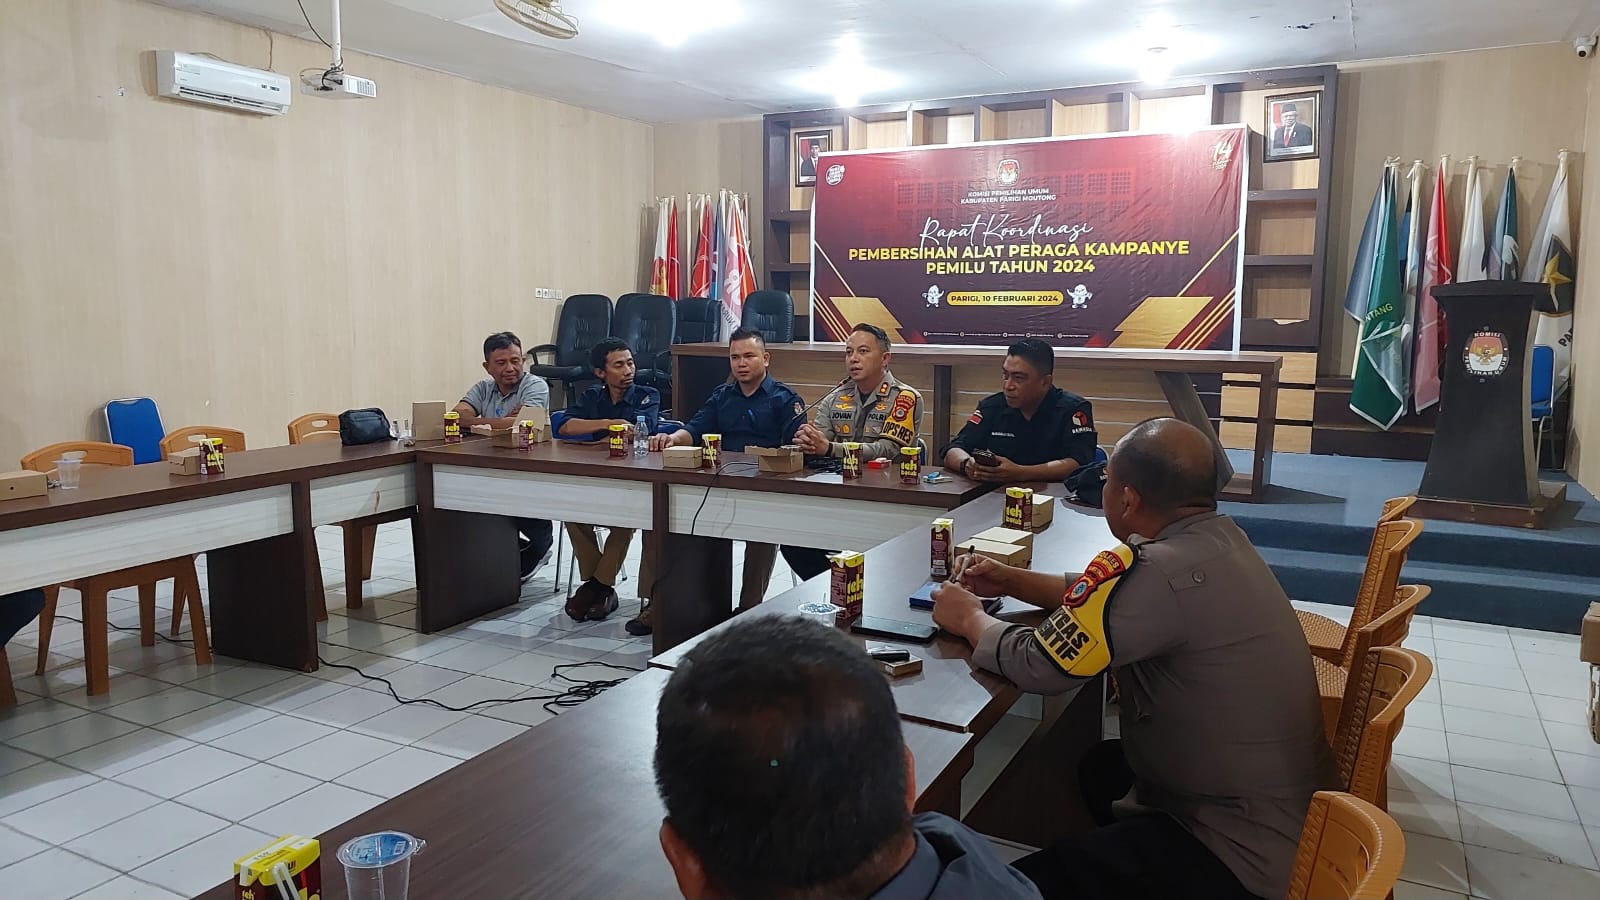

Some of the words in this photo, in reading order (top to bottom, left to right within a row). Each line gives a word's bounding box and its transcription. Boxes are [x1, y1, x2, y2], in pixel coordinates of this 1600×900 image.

[991, 189, 1026, 197] PEMILIHAN
[1022, 194, 1057, 202] MOUTONG
[920, 214, 987, 250] Rapat
[983, 214, 1093, 247] Koordinasi
[848, 246, 958, 261] PEMBERSIHAN
[961, 244, 1005, 259] ALAT
[1008, 242, 1080, 258] PERAGA
[1084, 240, 1190, 256] KAMPANYE
[926, 261, 985, 275] PEMILU
[989, 259, 1048, 274] TAHUN
[1052, 259, 1096, 273] 2024
[1558, 327, 1573, 347] PA
[831, 411, 852, 420] JOVAN
[868, 413, 887, 421] POLRI
